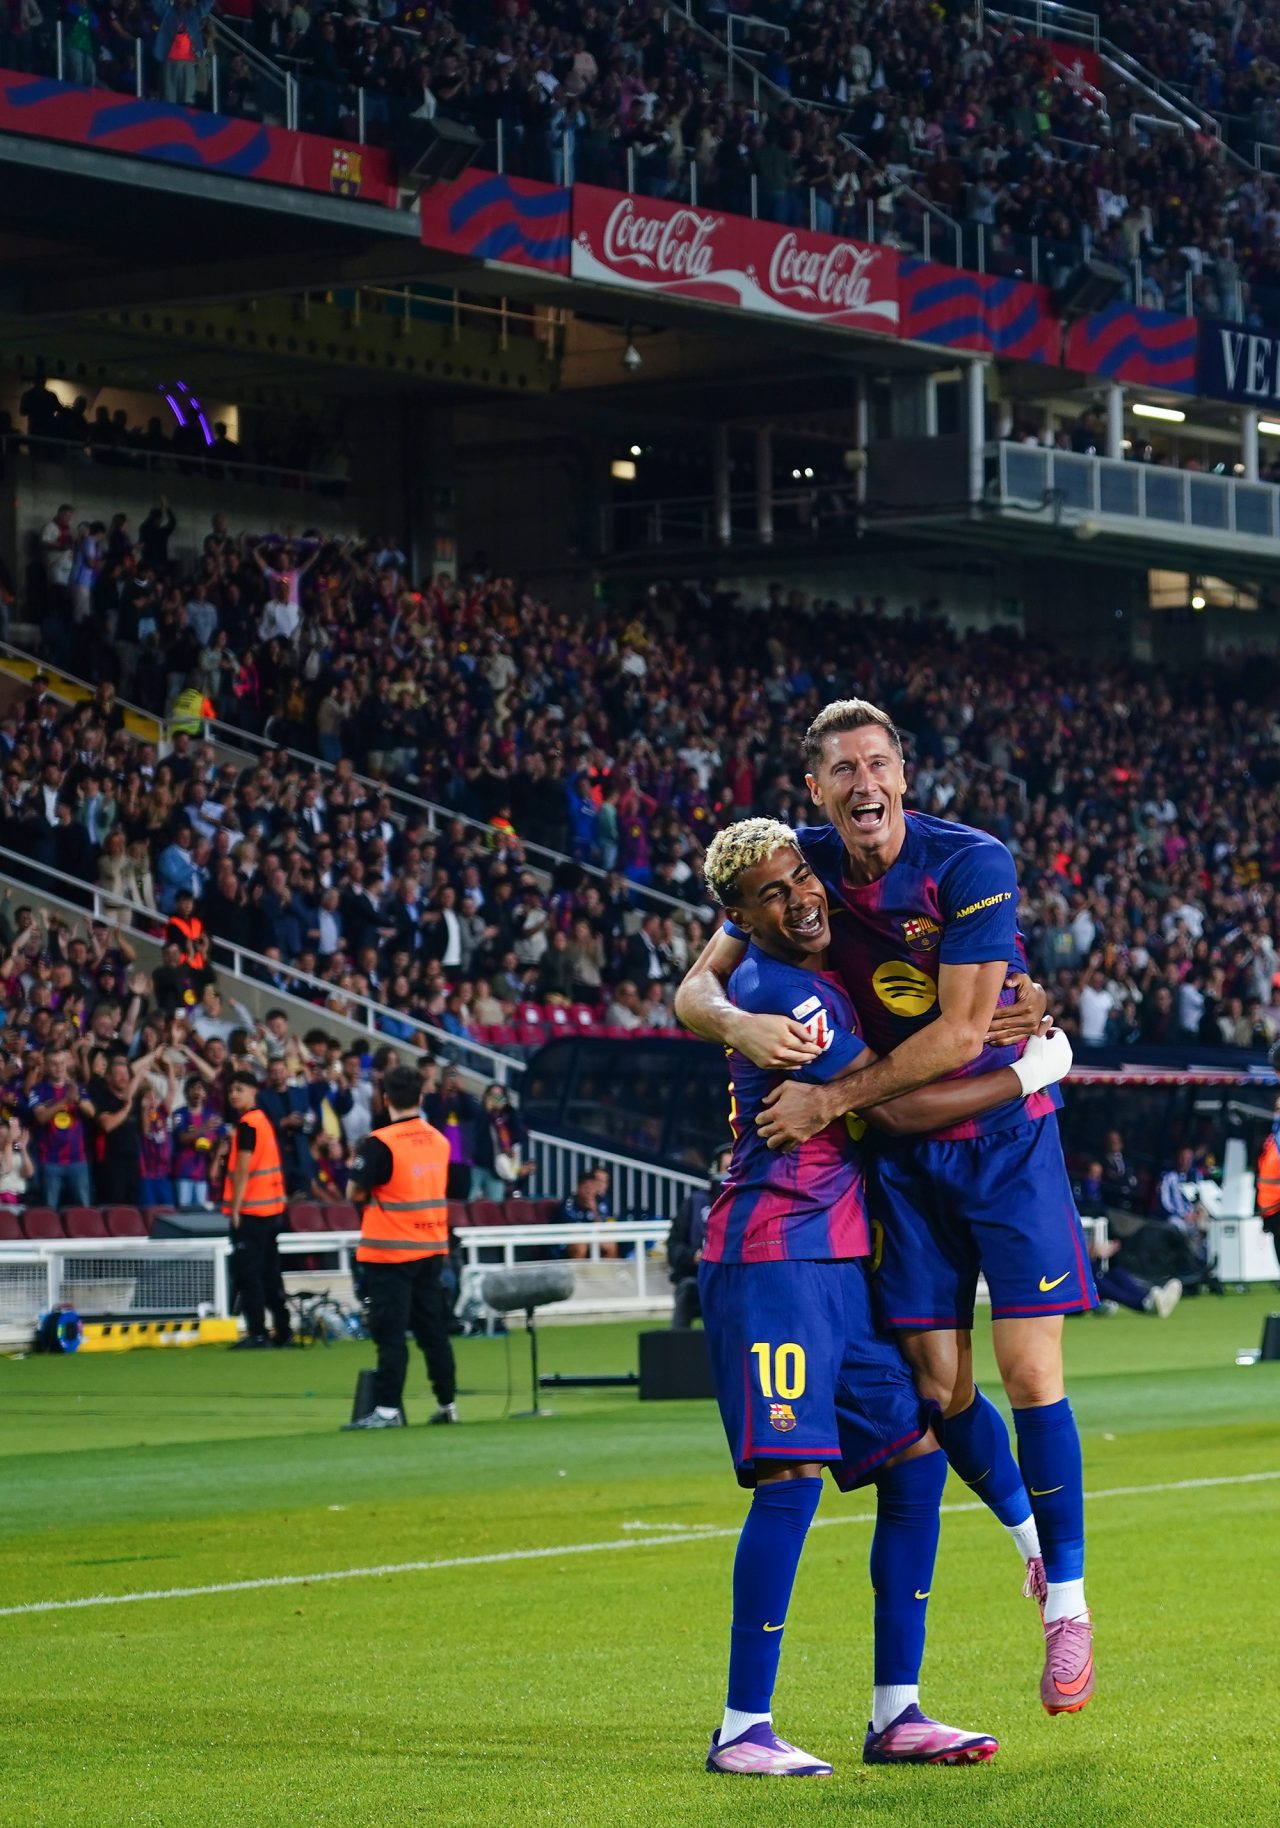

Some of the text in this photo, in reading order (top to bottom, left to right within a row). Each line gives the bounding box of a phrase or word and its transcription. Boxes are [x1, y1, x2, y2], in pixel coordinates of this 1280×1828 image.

[603, 197, 725, 277] Coca-Cola
[768, 231, 881, 308] Coca-Cola
[956, 893, 1003, 918] AMBILIGHT
[750, 1342, 806, 1400] 10
